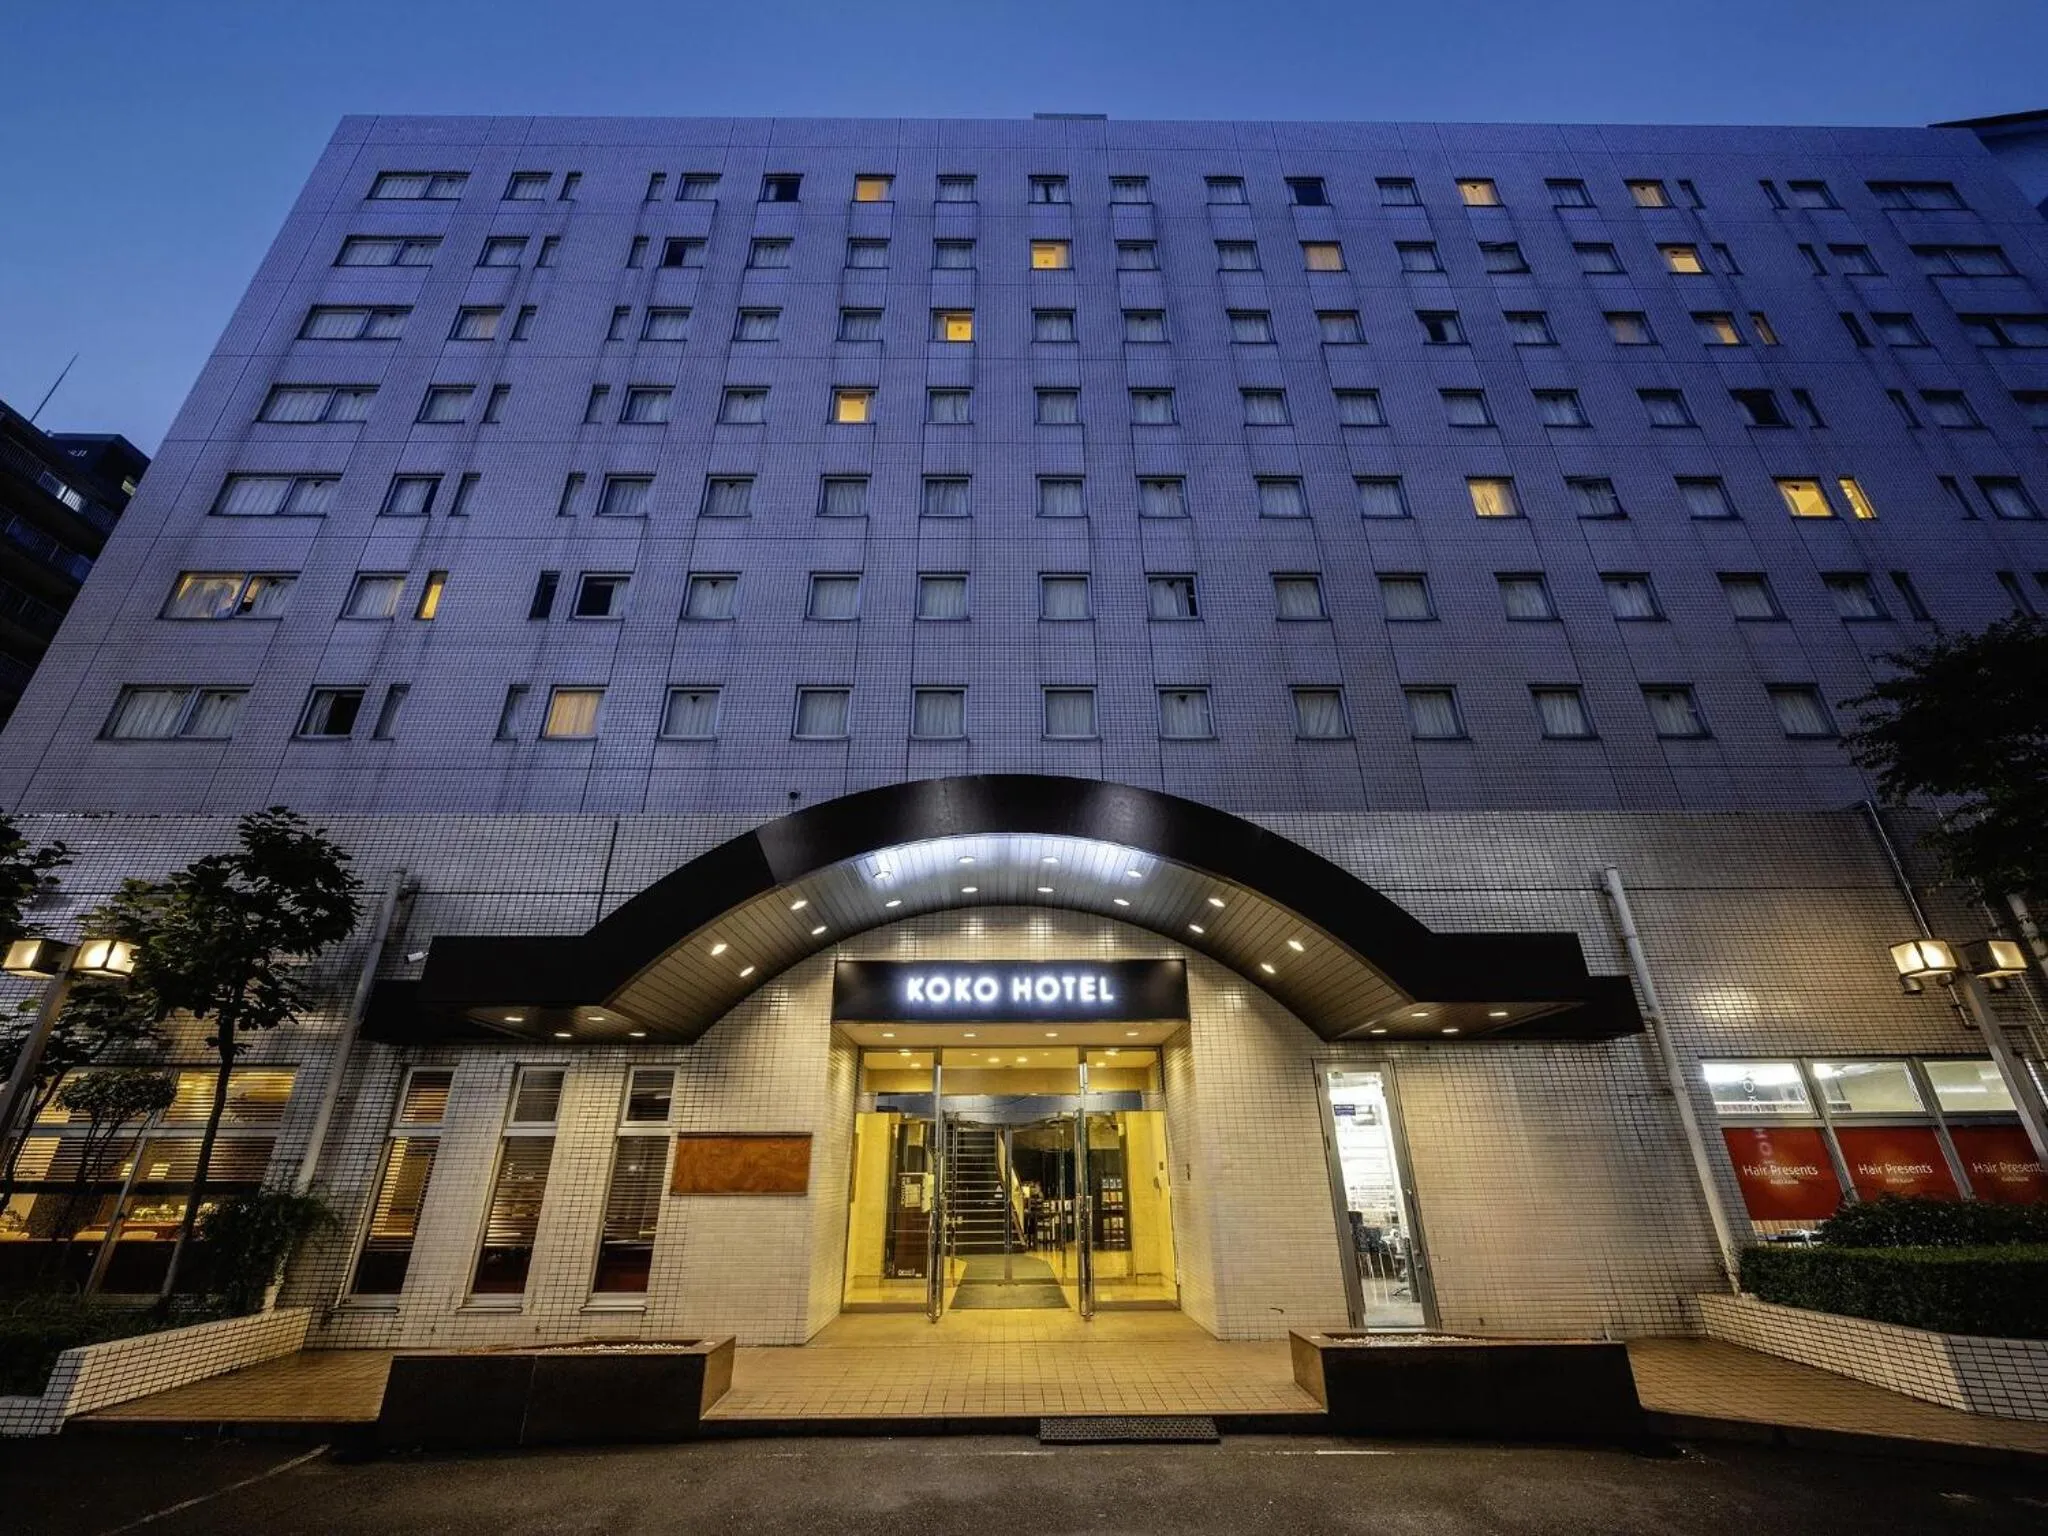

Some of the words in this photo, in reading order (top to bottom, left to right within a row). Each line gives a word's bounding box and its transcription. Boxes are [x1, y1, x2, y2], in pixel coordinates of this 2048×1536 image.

[906, 976, 999, 1002] KOKO
[1012, 976, 1114, 1001] HOTEL
[1743, 1163, 1768, 1176] Hair
[1770, 1164, 1818, 1175] Presents
[1858, 1163, 1882, 1175] Hair
[1885, 1163, 1933, 1174] Presents
[1973, 1162, 1997, 1173] Hair
[2000, 1162, 2045, 1173] Present
